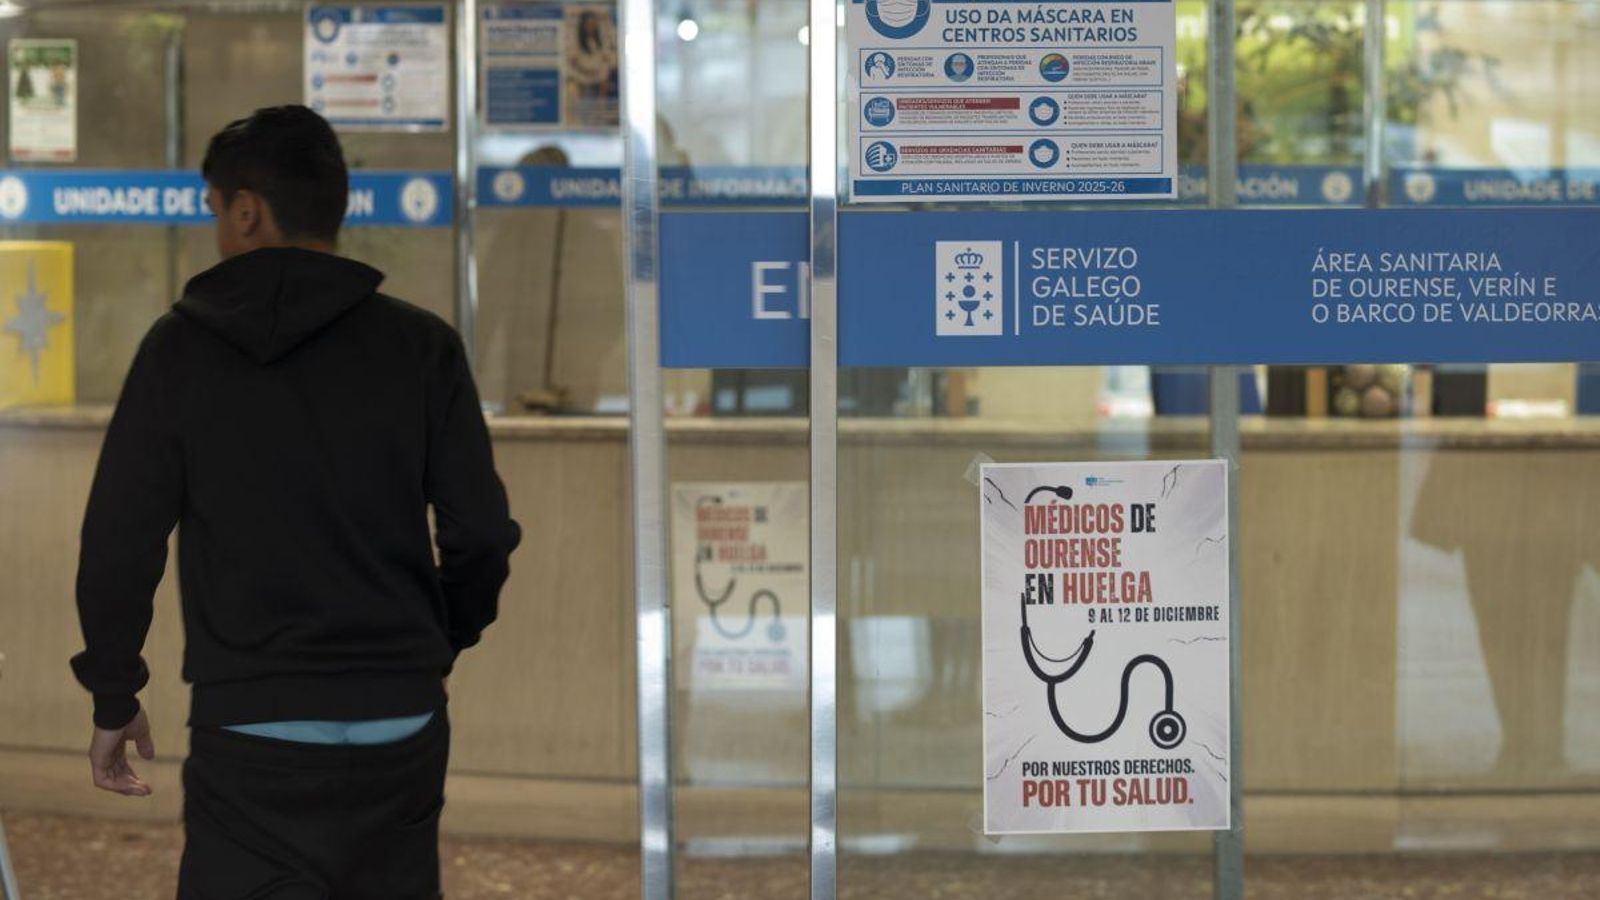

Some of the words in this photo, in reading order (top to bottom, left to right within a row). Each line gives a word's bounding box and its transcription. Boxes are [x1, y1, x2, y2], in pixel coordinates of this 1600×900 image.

[945, 9, 982, 24] USO
[987, 9, 1012, 24] DA
[1017, 4, 1106, 24] MÁSCARA
[1111, 9, 1134, 24] EN
[942, 27, 1026, 43] CENTROS
[1030, 26, 1138, 43] SANITARIOS
[550, 179, 620, 198] UNIDA
[901, 181, 933, 194] PLAN
[936, 181, 1000, 194] SANITARIO
[1003, 181, 1019, 193] DE
[1022, 181, 1075, 193] INVERNO
[1078, 180, 1125, 193] 2025-26
[53, 187, 159, 215] UNIDADE
[163, 187, 196, 215] DE
[1032, 247, 1137, 269] SERVIZO
[1311, 248, 1373, 272] ÁREA
[1380, 252, 1502, 272] SANITARIA
[751, 261, 810, 319] E
[1032, 275, 1141, 298] GALEGO
[1312, 278, 1342, 298] DE
[1349, 277, 1462, 300] OURENSE,
[1469, 272, 1536, 297] VERÍN
[1544, 277, 1557, 296] E
[1033, 305, 1065, 327] DE
[1069, 297, 1161, 327] SAÚDE
[1312, 304, 1329, 323] O
[1337, 303, 1415, 323] BARCO
[1424, 303, 1453, 322] DE
[1024, 499, 1124, 535] MÉDICOS
[1131, 503, 1156, 533] DE
[1024, 537, 1122, 569] OURENSE
[1025, 573, 1054, 605] EN
[1063, 571, 1153, 605] HUELGA
[1088, 608, 1096, 624] 9
[1100, 608, 1114, 623] AL
[1118, 608, 1131, 623] 12
[1135, 608, 1149, 623] DE
[1153, 605, 1220, 623] DICIEMBRE
[1022, 762, 1048, 777] POR
[1052, 760, 1120, 777] NUESTROS
[1124, 758, 1196, 775] DERECHOS.
[1022, 779, 1071, 808] POR
[1076, 778, 1106, 807] TU
[1112, 777, 1194, 807] SALUD.
